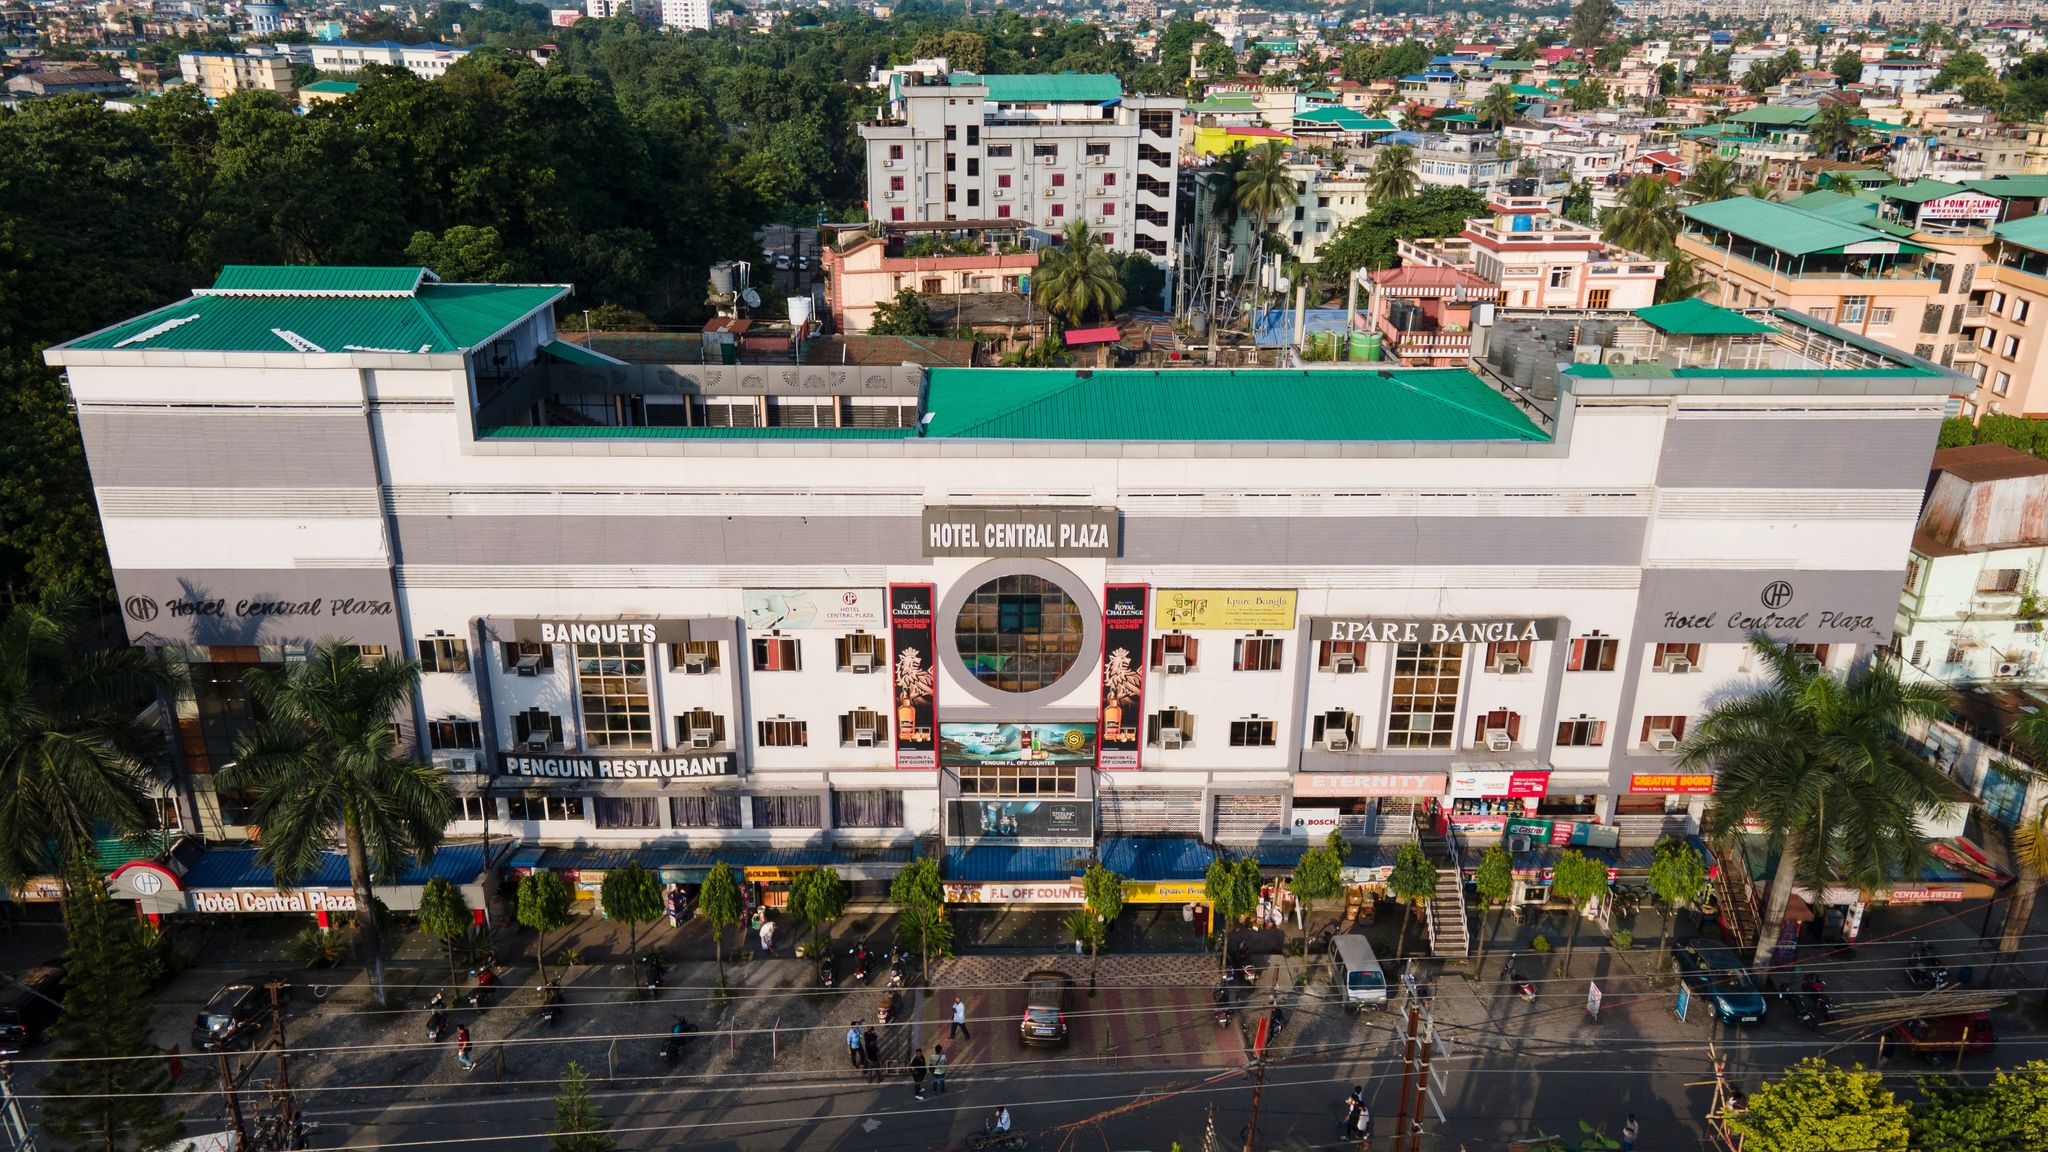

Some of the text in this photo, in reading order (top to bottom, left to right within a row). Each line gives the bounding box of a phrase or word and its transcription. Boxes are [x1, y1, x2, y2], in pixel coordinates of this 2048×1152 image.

[1944, 200, 1969, 208] POINT
[1972, 200, 2000, 208] CLINIC
[930, 523, 1109, 548] HOTEL CENTRAL PLAZA
[165, 597, 393, 618] Hotel Central Plaza
[1256, 596, 1288, 608] Bangla
[1664, 611, 1874, 631] Hotel Central Plaza
[541, 623, 657, 643] BANQUETS
[1330, 619, 1540, 643] EPARE BANGLA
[507, 756, 728, 778] PENGUIN RESTAURANT
[1312, 774, 1429, 788] ETERNITY
[1634, 776, 1712, 786] CREATIVE BOOKS
[1369, 788, 1398, 796] Kitchen
[1400, 788, 1443, 797] Appliances
[1518, 826, 1545, 835] Castrol
[746, 870, 777, 878] GOLDEN
[947, 891, 981, 903] BAR
[991, 888, 1085, 899] F.L. OFF COUNTE
[1893, 890, 1963, 899] CENTRAL SWEETS
[193, 891, 357, 913] Hotel Central Plaza
